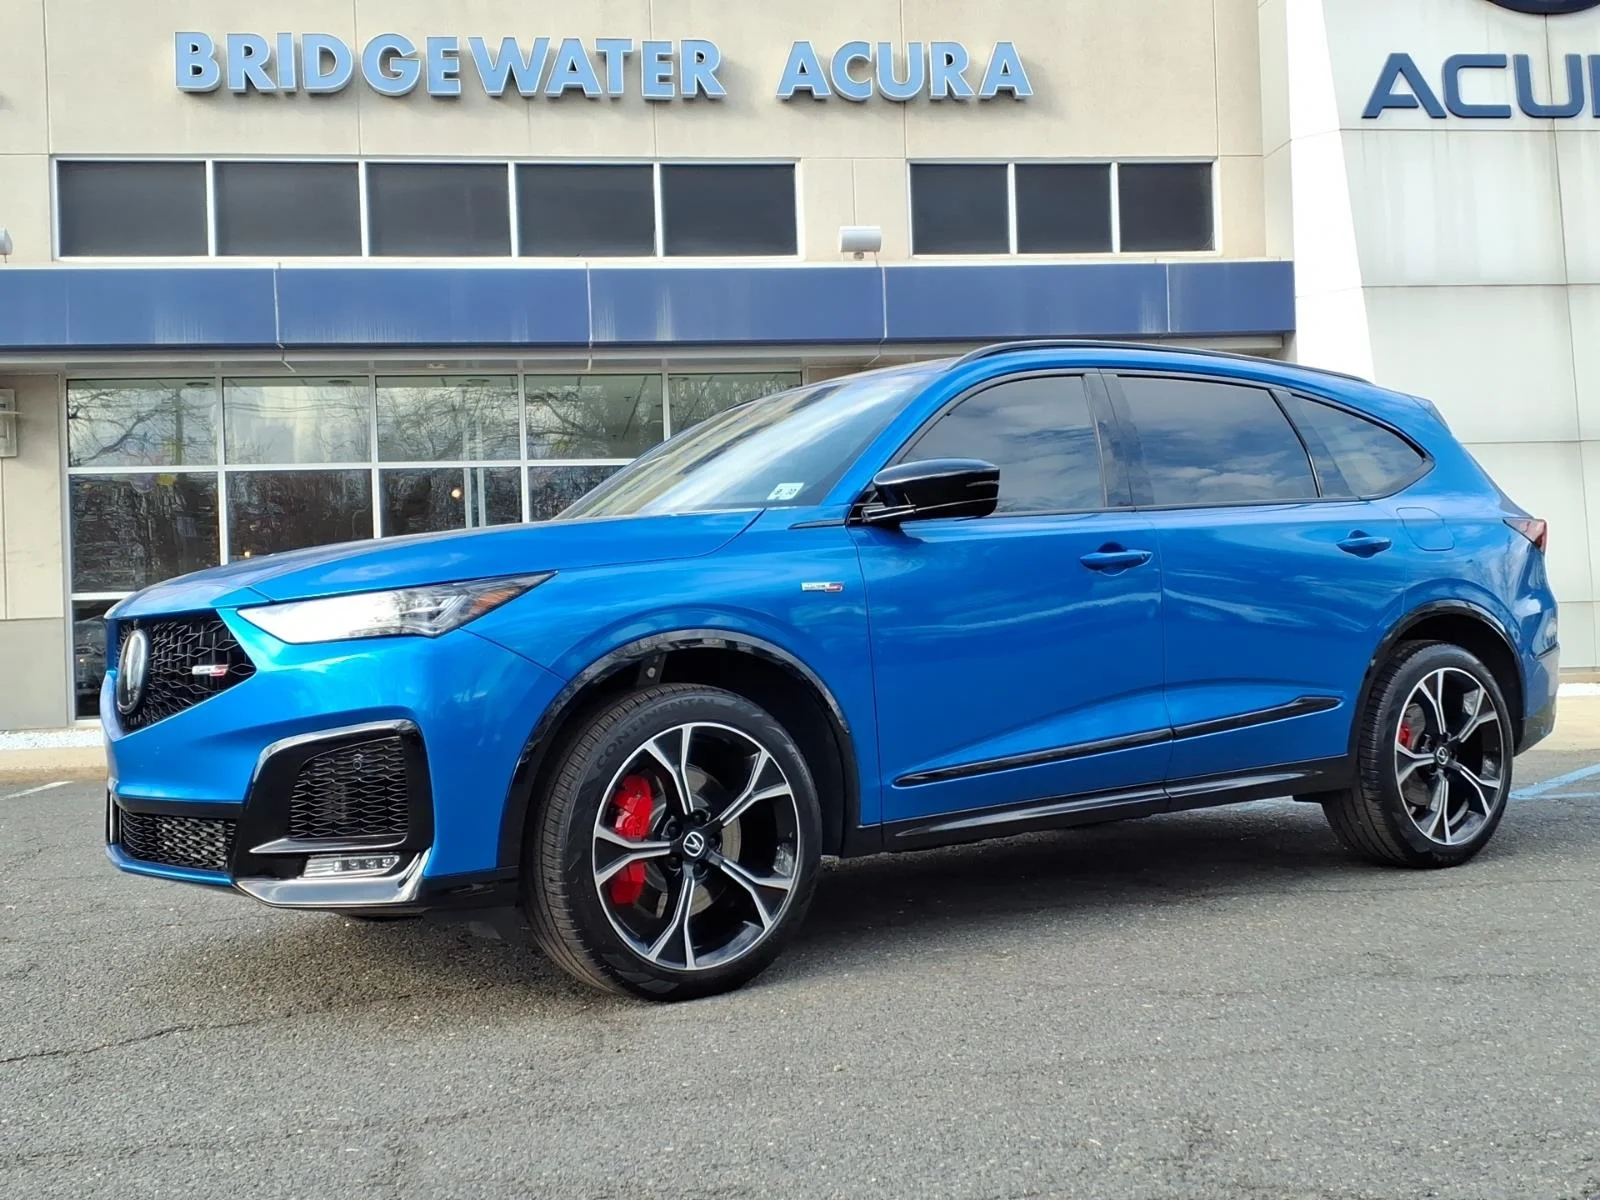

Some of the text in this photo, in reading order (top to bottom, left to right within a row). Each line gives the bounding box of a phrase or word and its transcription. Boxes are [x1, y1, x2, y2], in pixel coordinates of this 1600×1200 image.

[174, 31, 1033, 101] BRIDGEWATER ACURA
[1361, 52, 1600, 118] ACU
[596, 697, 716, 769] CONTINENTAL
